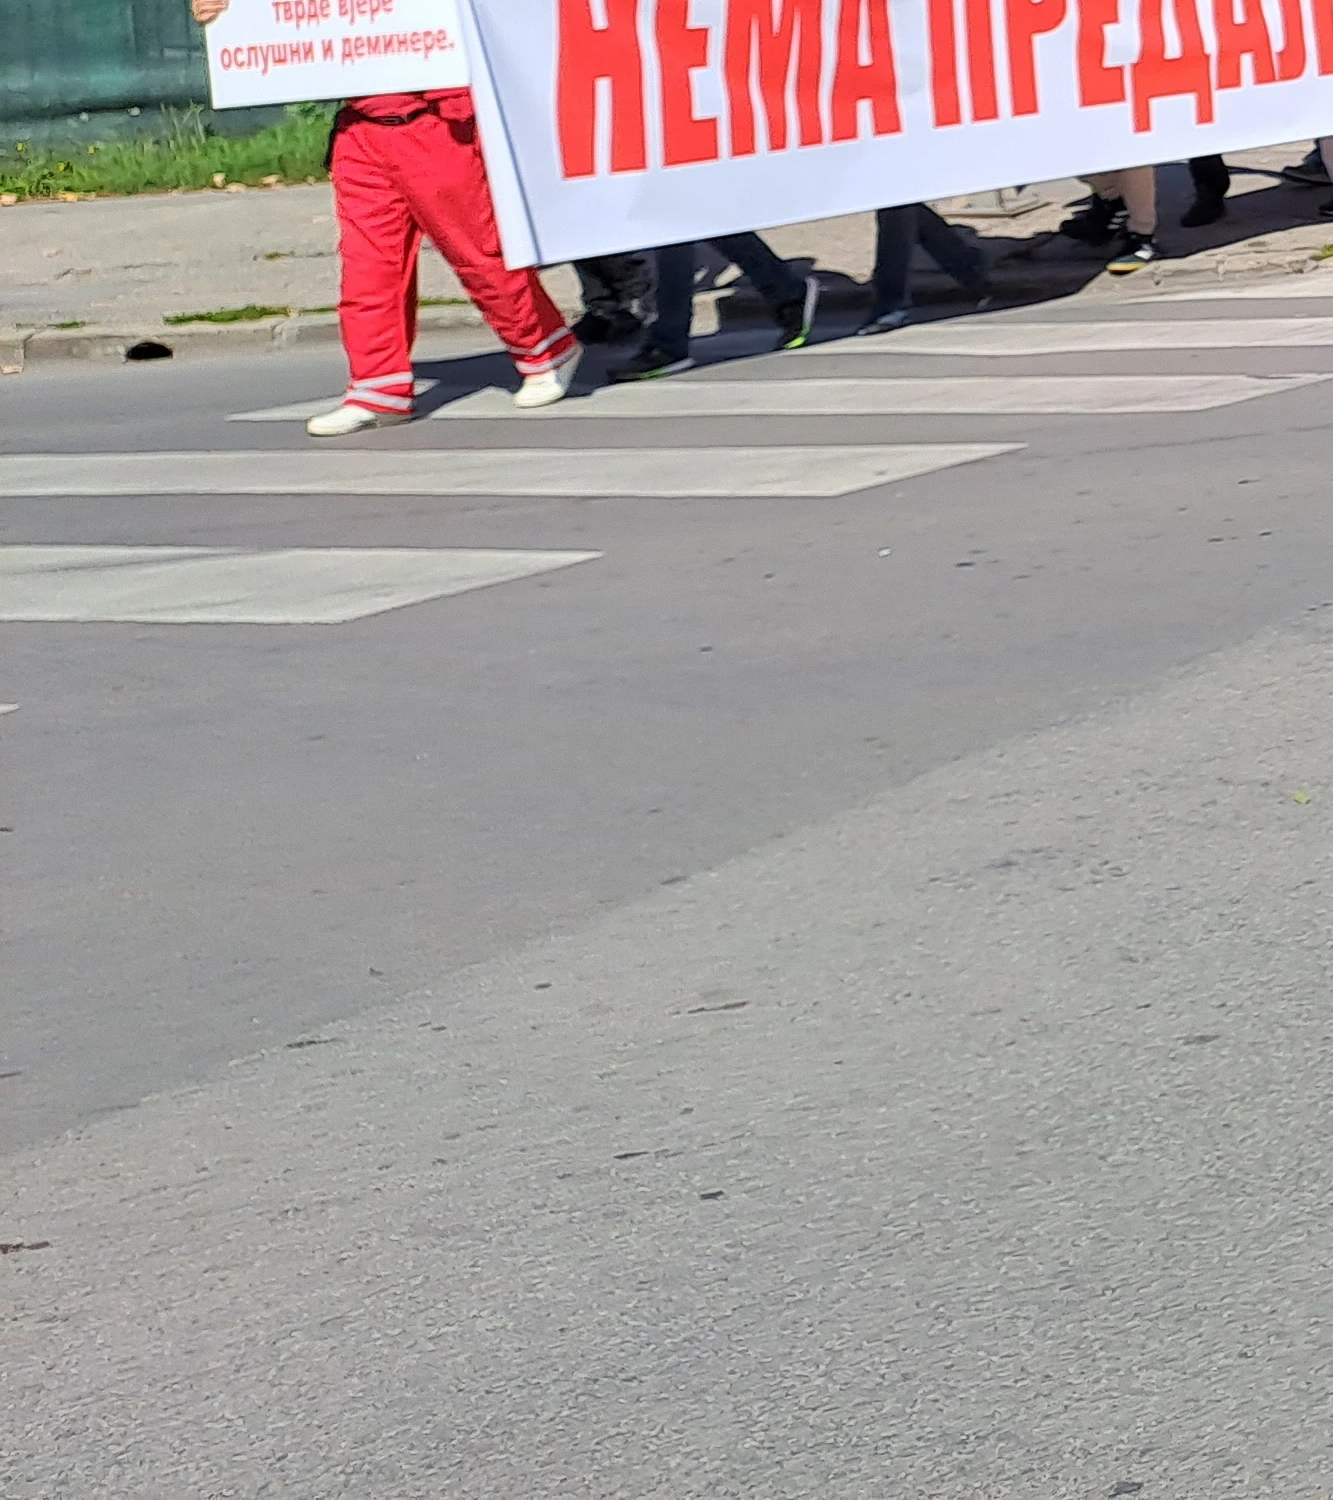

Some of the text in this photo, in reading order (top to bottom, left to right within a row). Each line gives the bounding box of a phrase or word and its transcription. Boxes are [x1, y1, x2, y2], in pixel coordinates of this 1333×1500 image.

[272, 0, 331, 28] тврде
[220, 26, 456, 76] ослушни и деминере.
